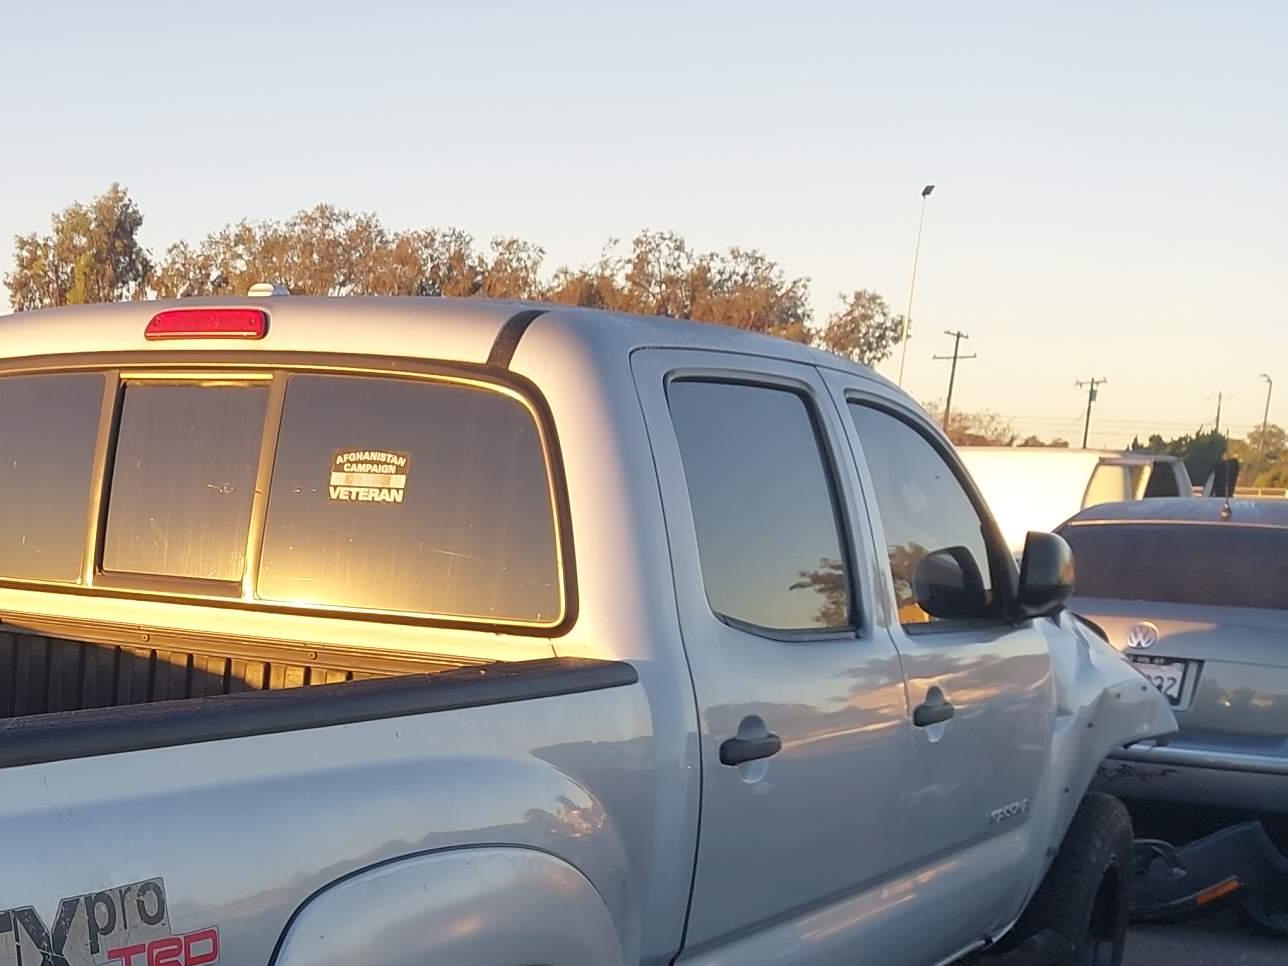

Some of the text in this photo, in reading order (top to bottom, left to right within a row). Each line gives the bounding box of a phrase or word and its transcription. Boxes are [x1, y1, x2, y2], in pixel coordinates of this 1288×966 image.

[336, 451, 407, 467] AFGHANISTAN
[343, 463, 397, 474] CAMPAIGN
[329, 486, 404, 503] VETERAN
